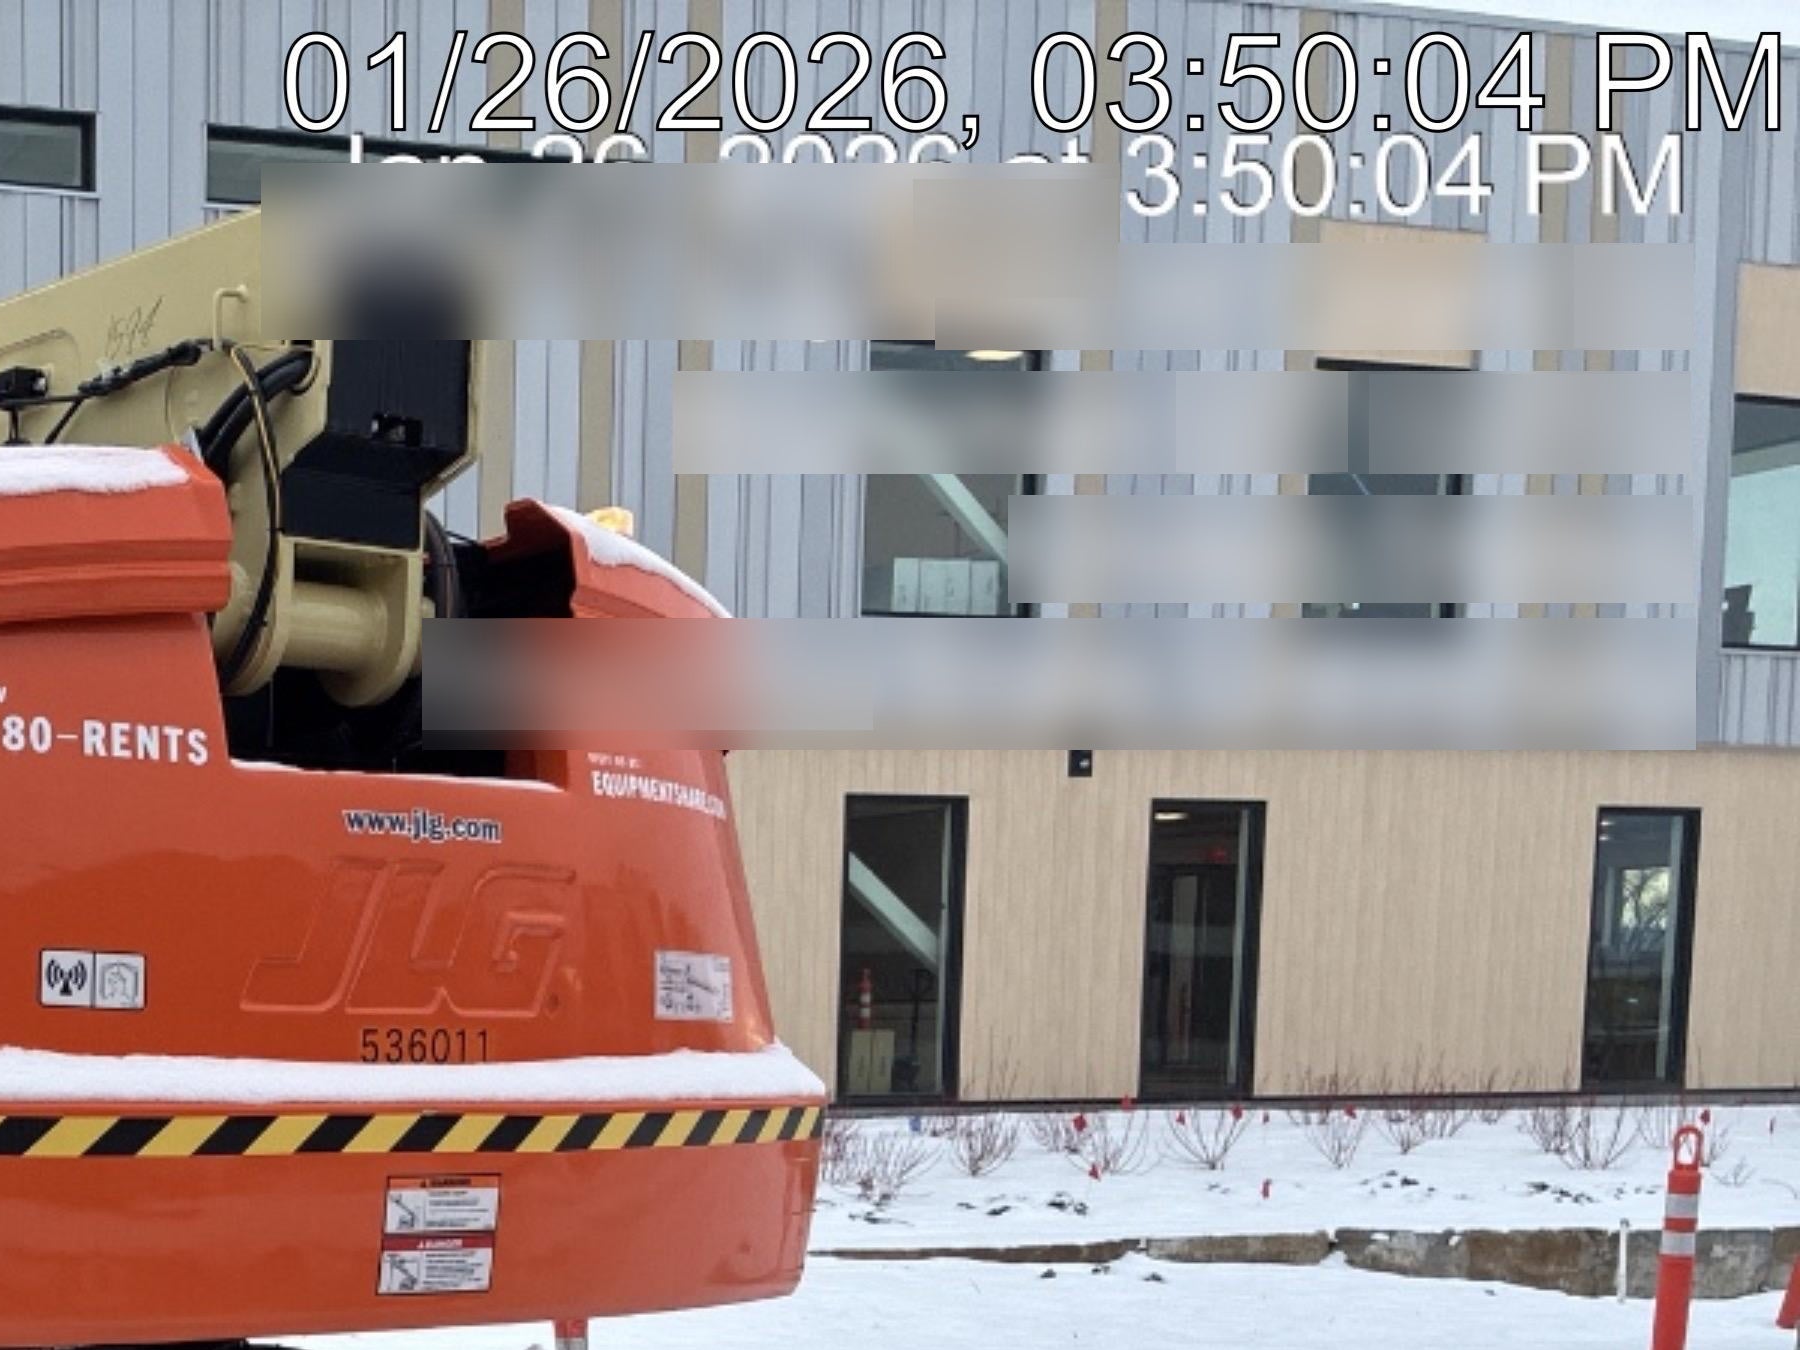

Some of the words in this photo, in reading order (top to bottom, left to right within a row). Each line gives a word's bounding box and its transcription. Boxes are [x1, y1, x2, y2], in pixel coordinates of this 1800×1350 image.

[342, 807, 502, 844] www.jlg.com
[240, 856, 576, 1018] JLG
[361, 1027, 489, 1063] 536011
